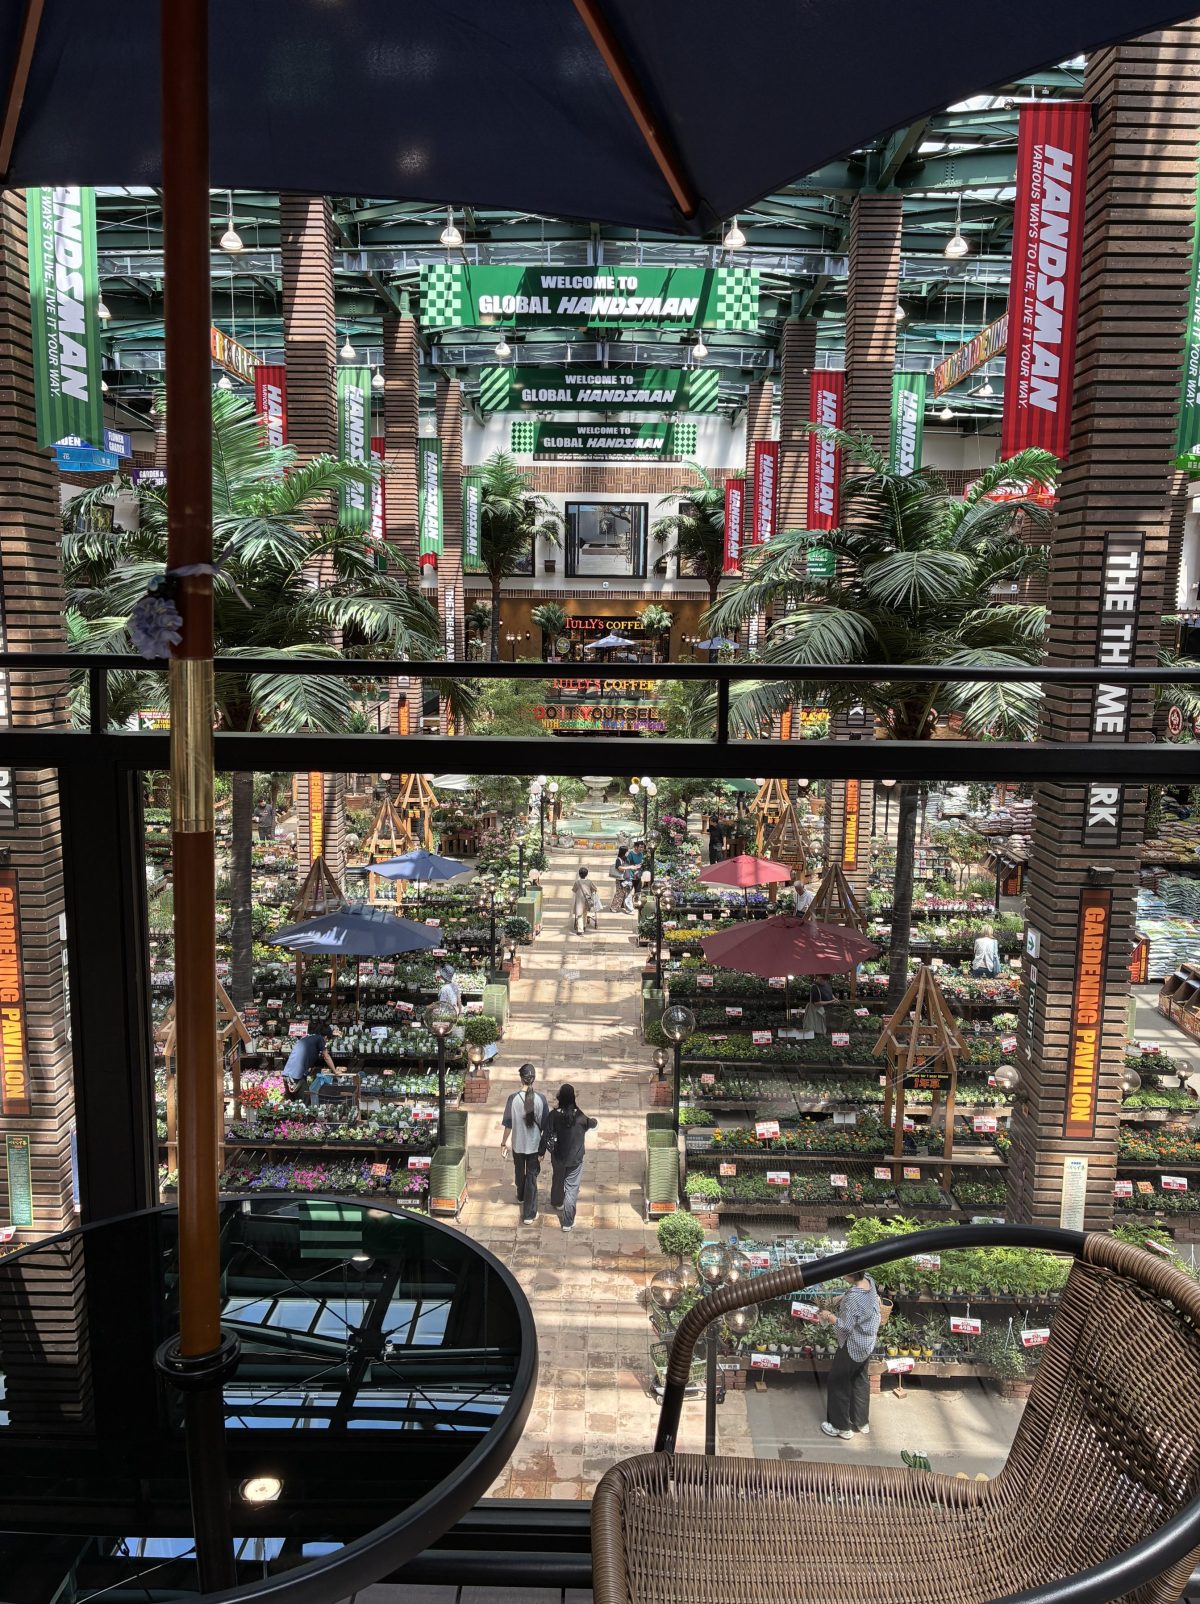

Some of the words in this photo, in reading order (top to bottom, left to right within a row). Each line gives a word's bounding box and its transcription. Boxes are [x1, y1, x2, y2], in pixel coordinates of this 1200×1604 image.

[1031, 143, 1044, 199] VARIOUS
[41, 196, 52, 232] WAYS
[1028, 203, 1040, 239] WAYS
[43, 233, 53, 251] TO
[1027, 242, 1038, 259] TO
[44, 253, 55, 285] LIVE,
[540, 275, 616, 290] WELCOME
[617, 276, 638, 290] TO
[1024, 261, 1037, 292] LIVE,
[1029, 143, 1073, 413] HANDSMAN
[45, 286, 56, 313] LIVE
[53, 186, 88, 402] ANDSMAN
[478, 295, 552, 315] GLOBAL
[556, 296, 699, 321] HANDSMAN
[1023, 296, 1035, 325] LIVE
[46, 316, 57, 330] IT
[1022, 327, 1032, 340] IT
[47, 333, 59, 366] YOUR
[1020, 343, 1032, 377] YOUR
[1189, 342, 1200, 377] YOUR
[49, 368, 60, 397] WAY.
[521, 388, 574, 402] GLOBAL
[576, 389, 677, 403] HANDSMAN
[564, 374, 616, 385] WELCOME
[617, 375, 634, 385] TO
[1018, 379, 1029, 409] WAY.
[1184, 379, 1197, 409] WAY.
[268, 384, 283, 447] HAND
[577, 426, 618, 435] WELCOME
[350, 384, 365, 510] HANDSAN
[543, 437, 584, 448] GLOBAL
[586, 438, 665, 449] HANDSMAN
[820, 389, 837, 516] HADSMAN
[427, 451, 439, 540] HANDSMAN
[762, 454, 774, 542] HANDSMAN
[470, 486, 478, 556] HANDSMAN
[731, 489, 741, 560] HANDSMAN
[445, 589, 455, 608] THE
[1105, 552, 1138, 612] THE
[445, 607, 455, 640] THEME
[565, 617, 604, 629] TULLY'S
[446, 643, 455, 662] PAR
[604, 679, 655, 690] COFFEE
[1095, 624, 1131, 733] THME
[561, 705, 575, 720] IT
[580, 705, 659, 720] YOURSEL
[311, 772, 322, 811] DENING
[845, 814, 857, 862] PAVILION
[0, 887, 20, 1003] GARDENING
[1077, 907, 1106, 1024] GARDENING
[1026, 987, 1037, 1039] TOILET
[1, 1006, 25, 1099] PAVILION
[1070, 1030, 1098, 1121] PAVILION
